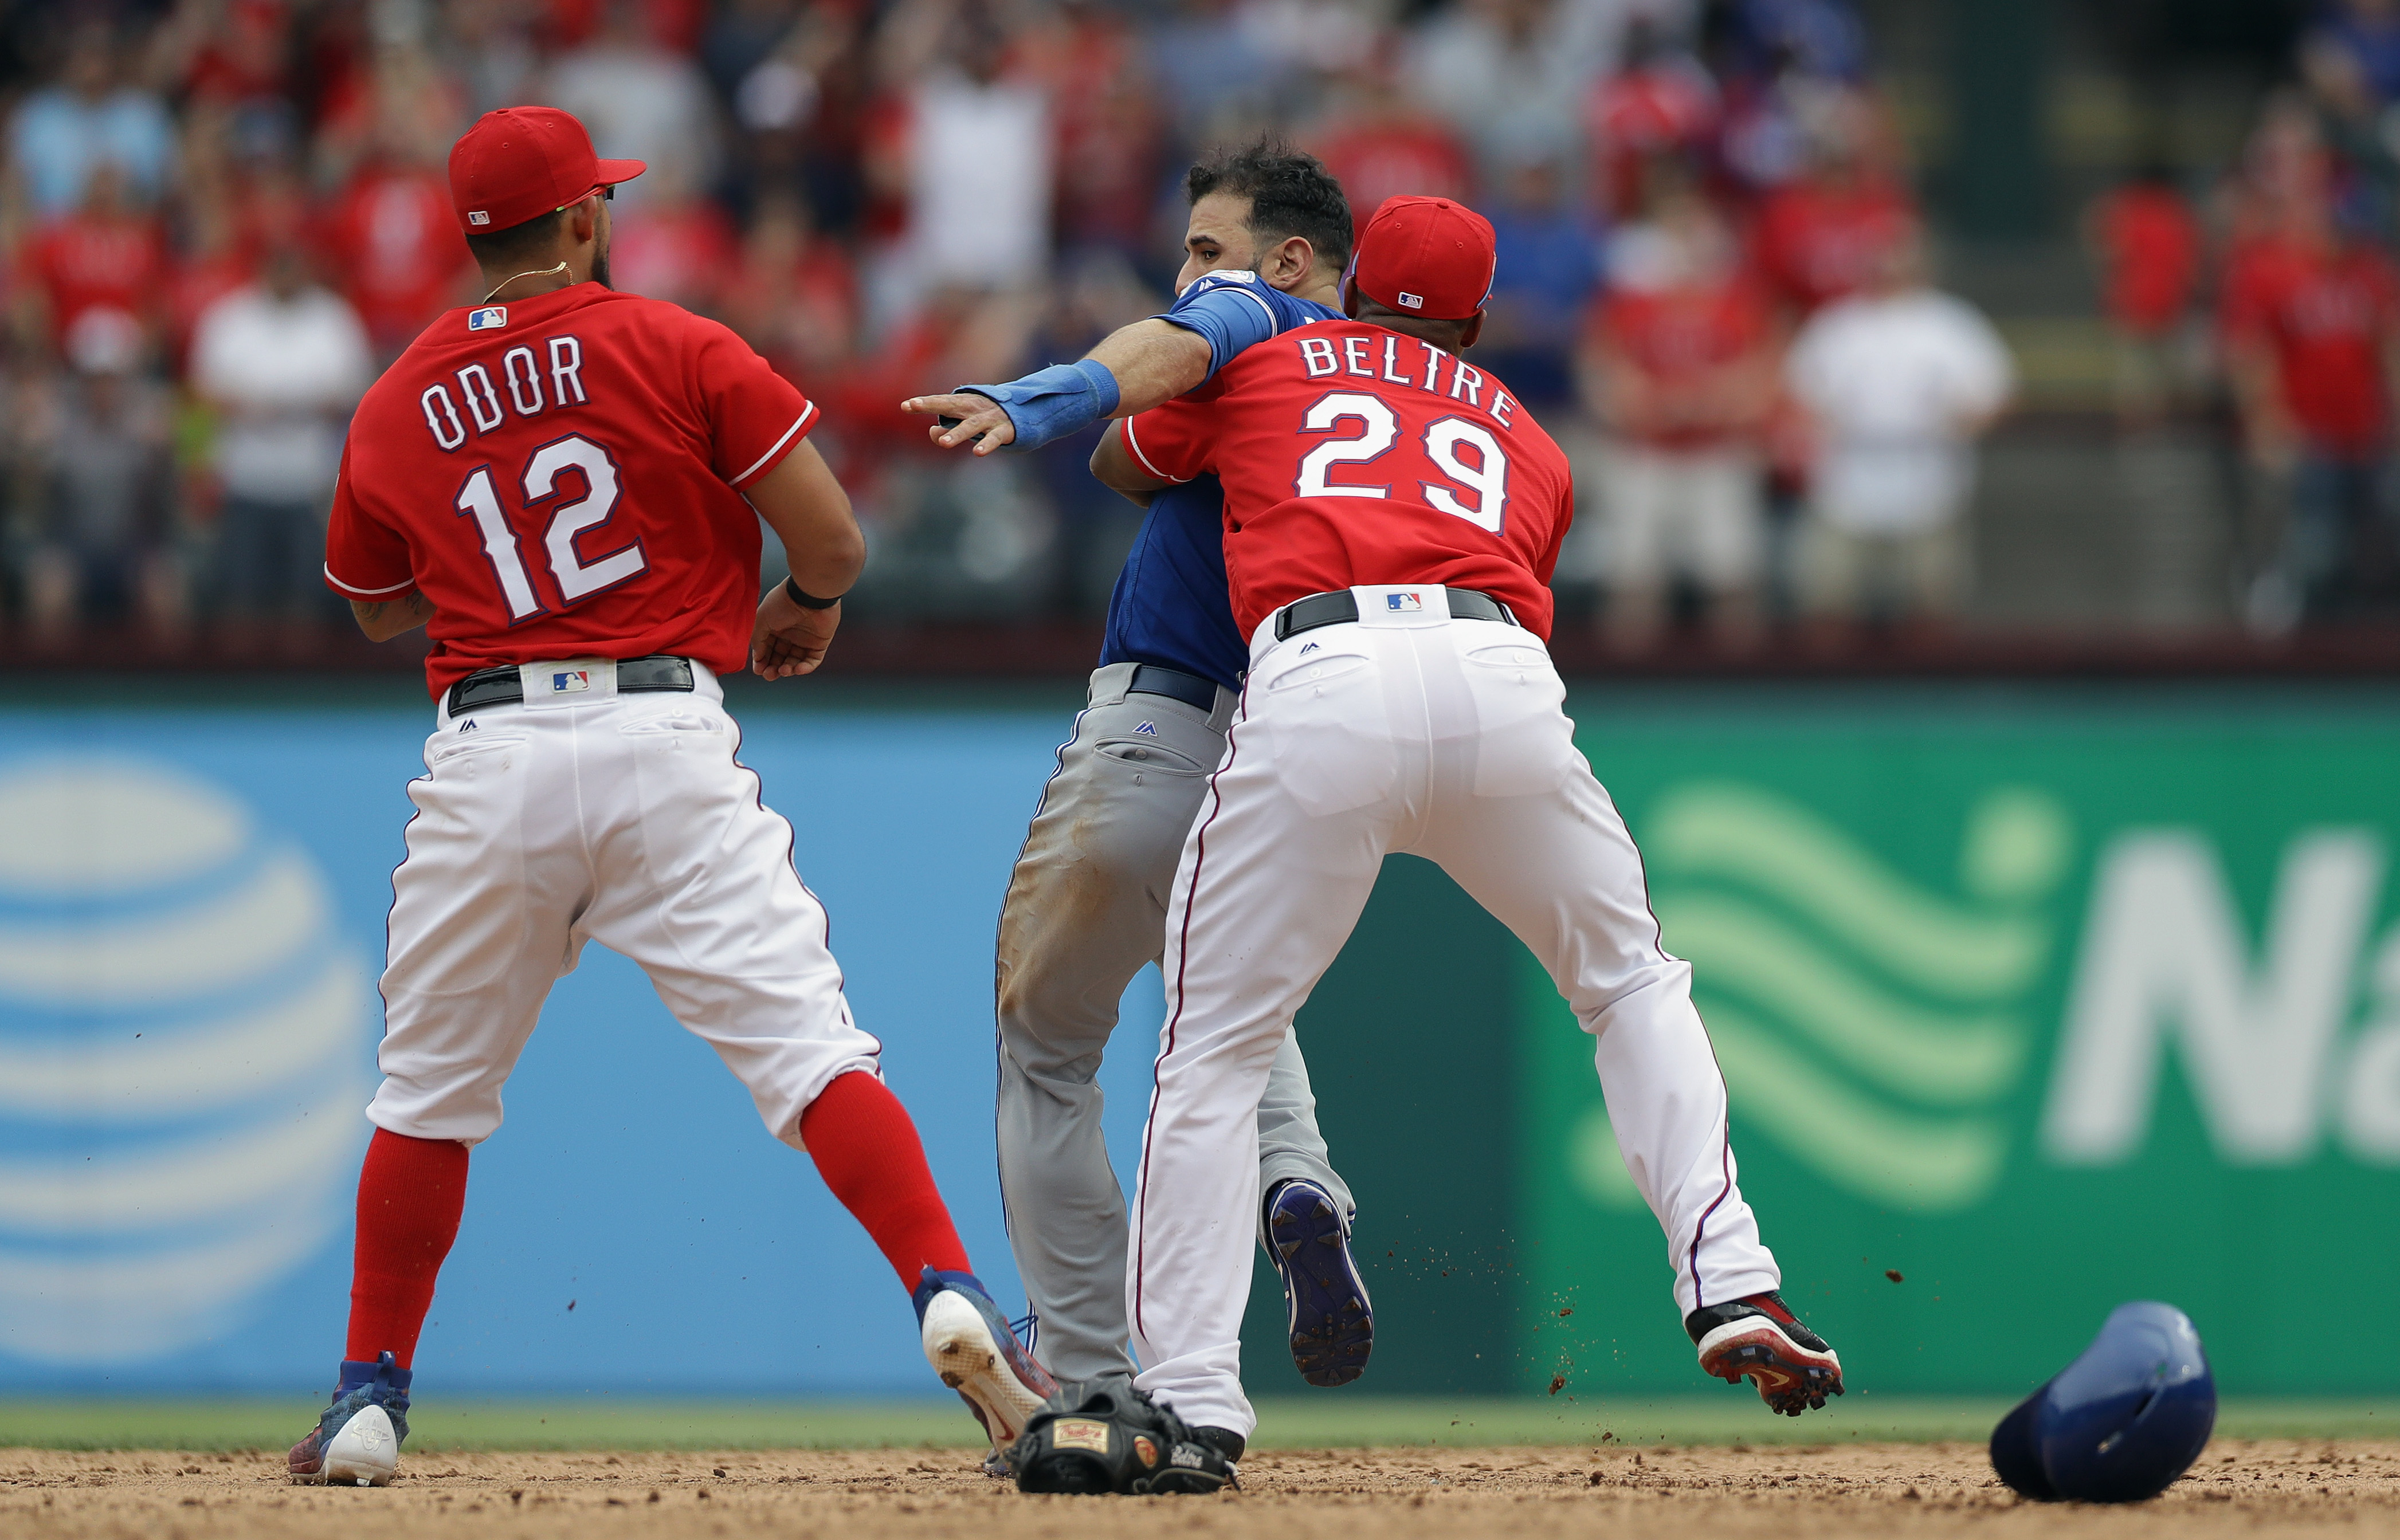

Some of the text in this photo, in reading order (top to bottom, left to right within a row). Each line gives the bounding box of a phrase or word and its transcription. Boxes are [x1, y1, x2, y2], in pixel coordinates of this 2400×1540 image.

[419, 333, 590, 454] ODOR
[1295, 335, 1519, 431] BELTRE
[453, 431, 650, 627] 12
[1291, 390, 1510, 537] 29
